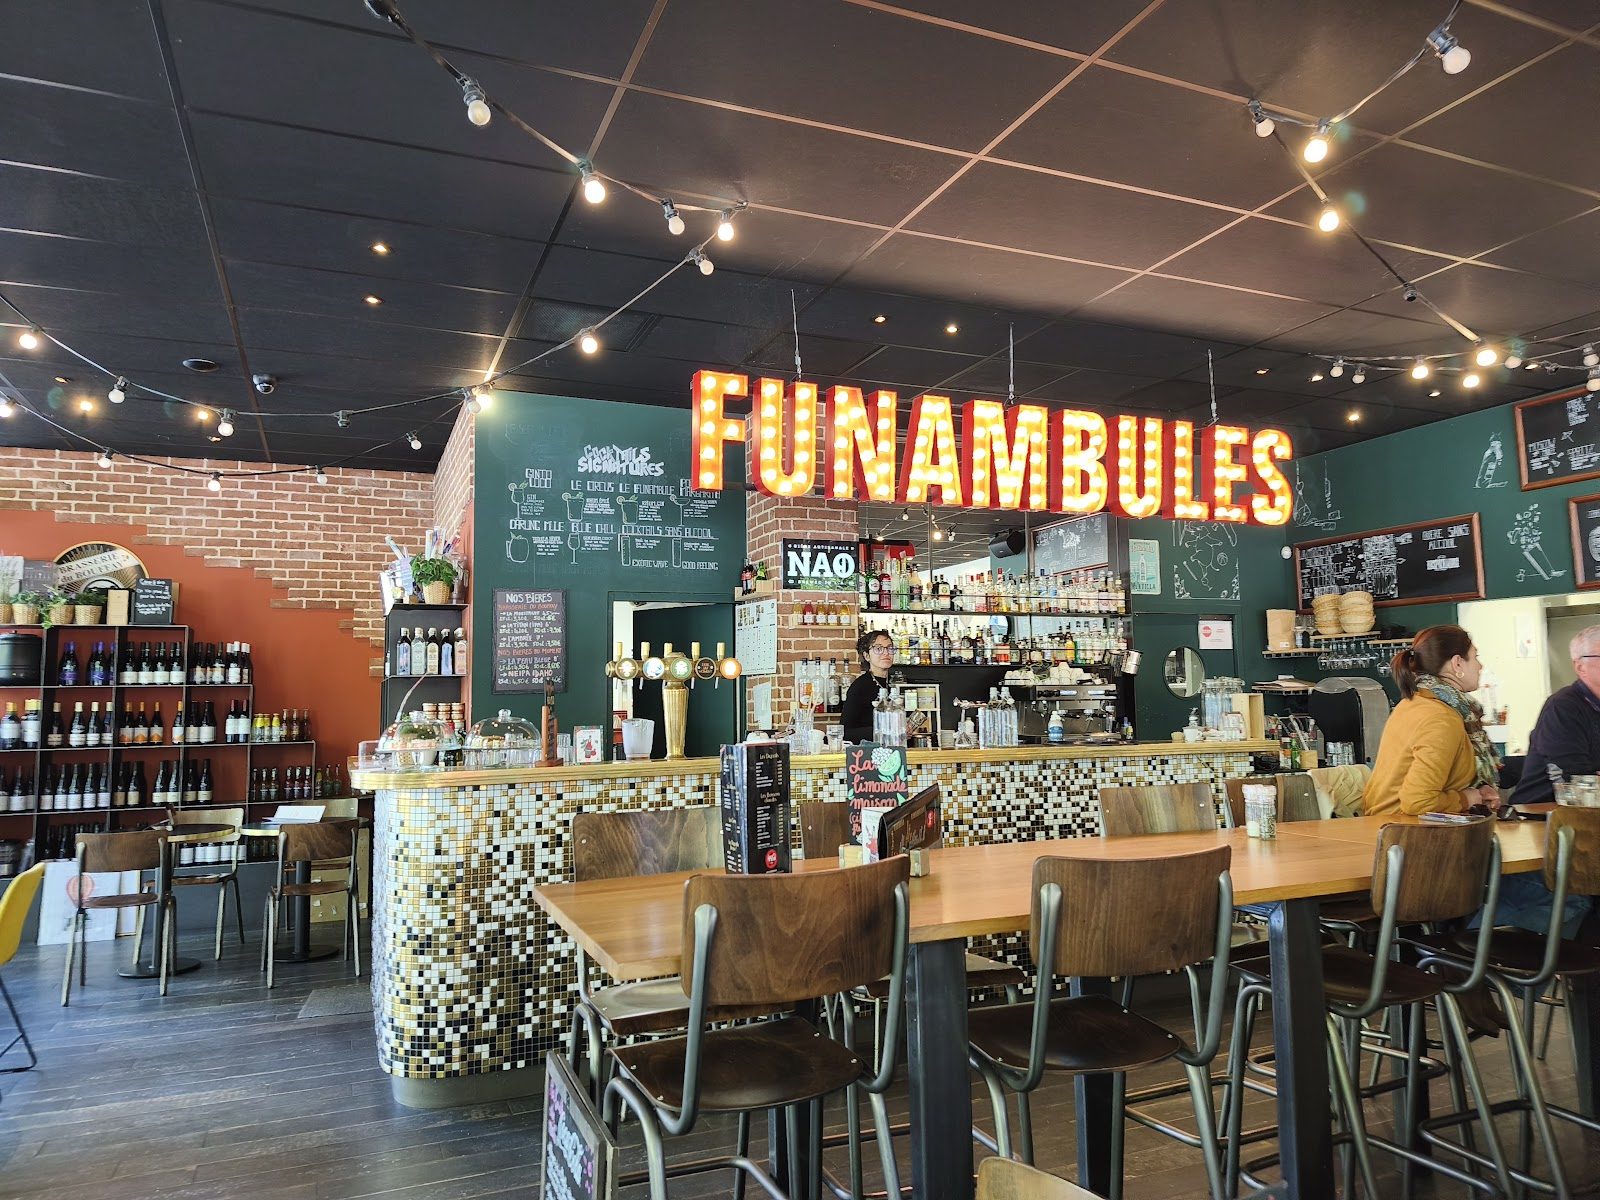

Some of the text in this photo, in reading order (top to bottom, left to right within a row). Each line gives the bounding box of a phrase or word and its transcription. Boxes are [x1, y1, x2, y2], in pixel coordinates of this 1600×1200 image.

[583, 444, 650, 464] COCKTAILS
[692, 369, 1293, 526] FUNAMBULES
[578, 456, 664, 477] SIGNATURES
[634, 484, 675, 496] FUNAMBULE
[509, 519, 540, 531] DARLING
[622, 525, 714, 539] COCKTAILS SANS ALCOOL
[58, 552, 119, 574] BRASSERIE
[788, 551, 855, 579] NAO
[506, 593, 524, 604] NOS
[508, 657, 516, 665] LA
[508, 669, 553, 678] NEIPA IDAHO
[849, 749, 875, 774] La
[852, 774, 908, 794] limonade
[850, 794, 897, 810] maison
